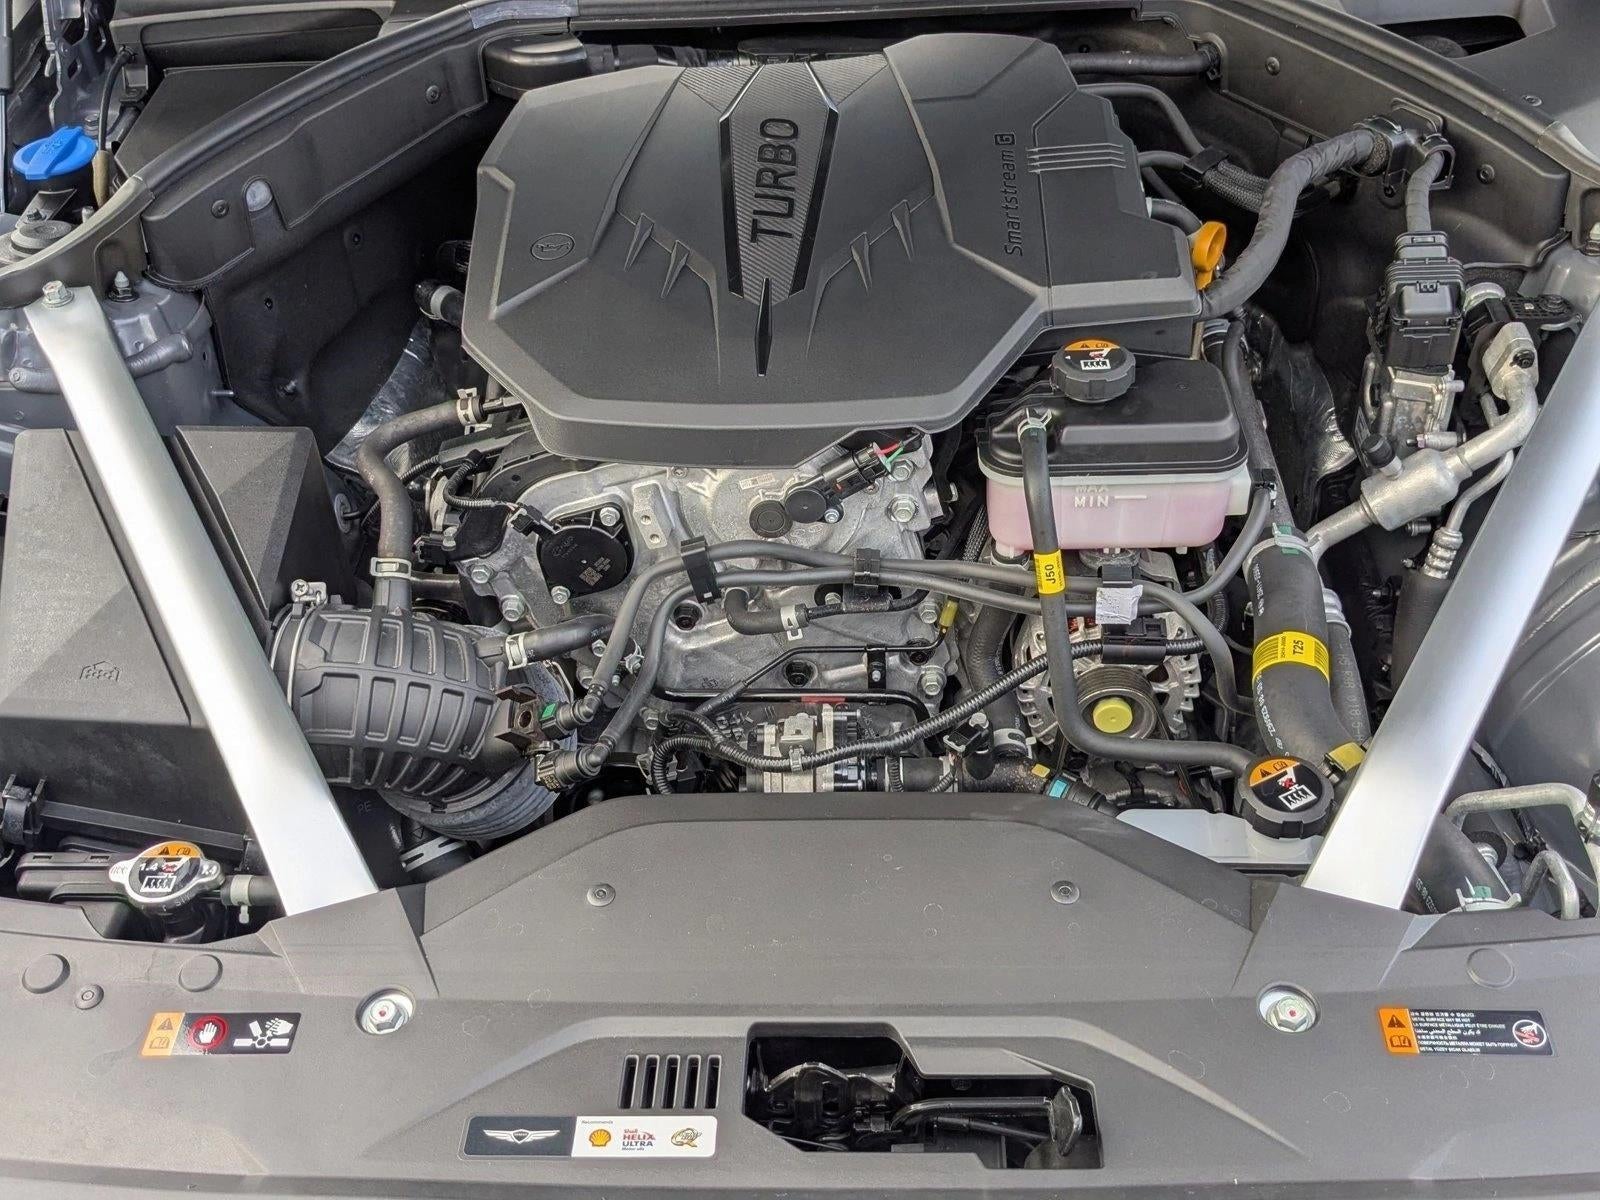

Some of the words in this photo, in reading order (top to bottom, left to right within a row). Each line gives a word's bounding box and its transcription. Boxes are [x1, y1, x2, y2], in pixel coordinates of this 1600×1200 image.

[751, 118, 799, 244] TURBO
[999, 151, 1023, 257] Smartstream
[1074, 495, 1109, 508] MIN
[1044, 564, 1056, 584] J50
[1293, 639, 1304, 655] T25
